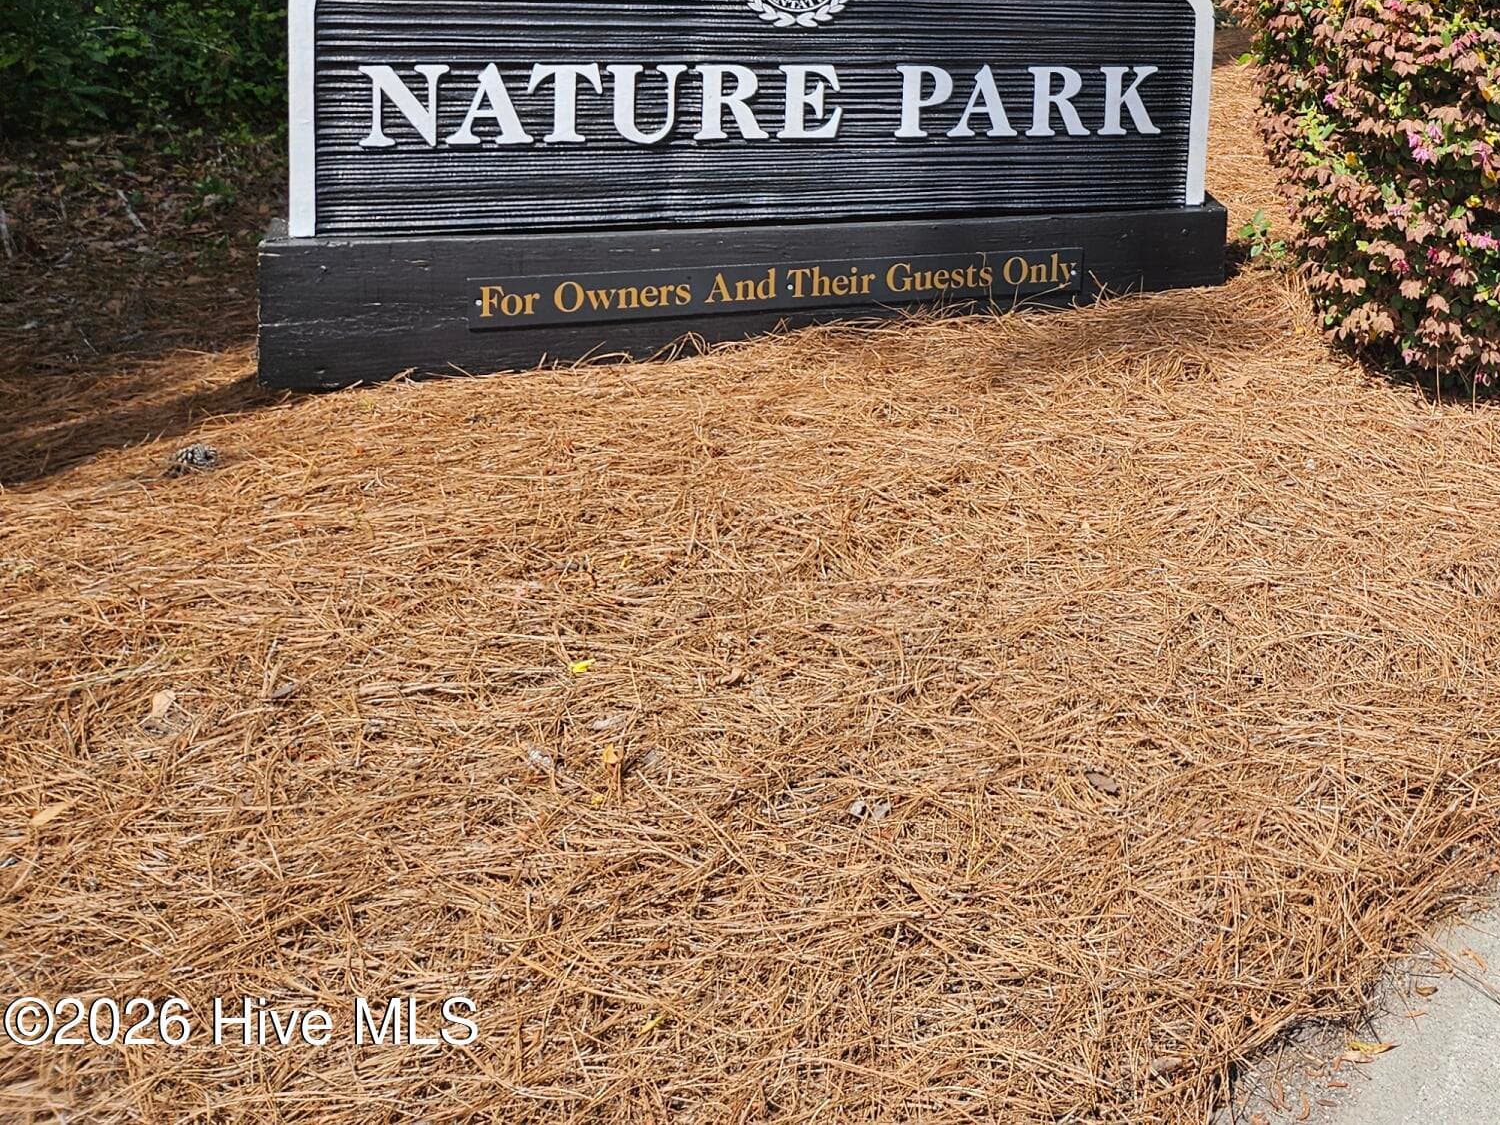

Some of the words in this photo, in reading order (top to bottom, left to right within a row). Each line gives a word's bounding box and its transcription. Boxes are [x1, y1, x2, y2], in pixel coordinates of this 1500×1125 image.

[358, 62, 843, 148] NATURE
[895, 64, 1162, 140] PARK
[479, 285, 540, 317] For
[554, 281, 691, 313] Owners
[703, 267, 776, 304] And
[787, 265, 875, 298] Their
[886, 262, 993, 291] Guests
[1003, 252, 1077, 288] Only
